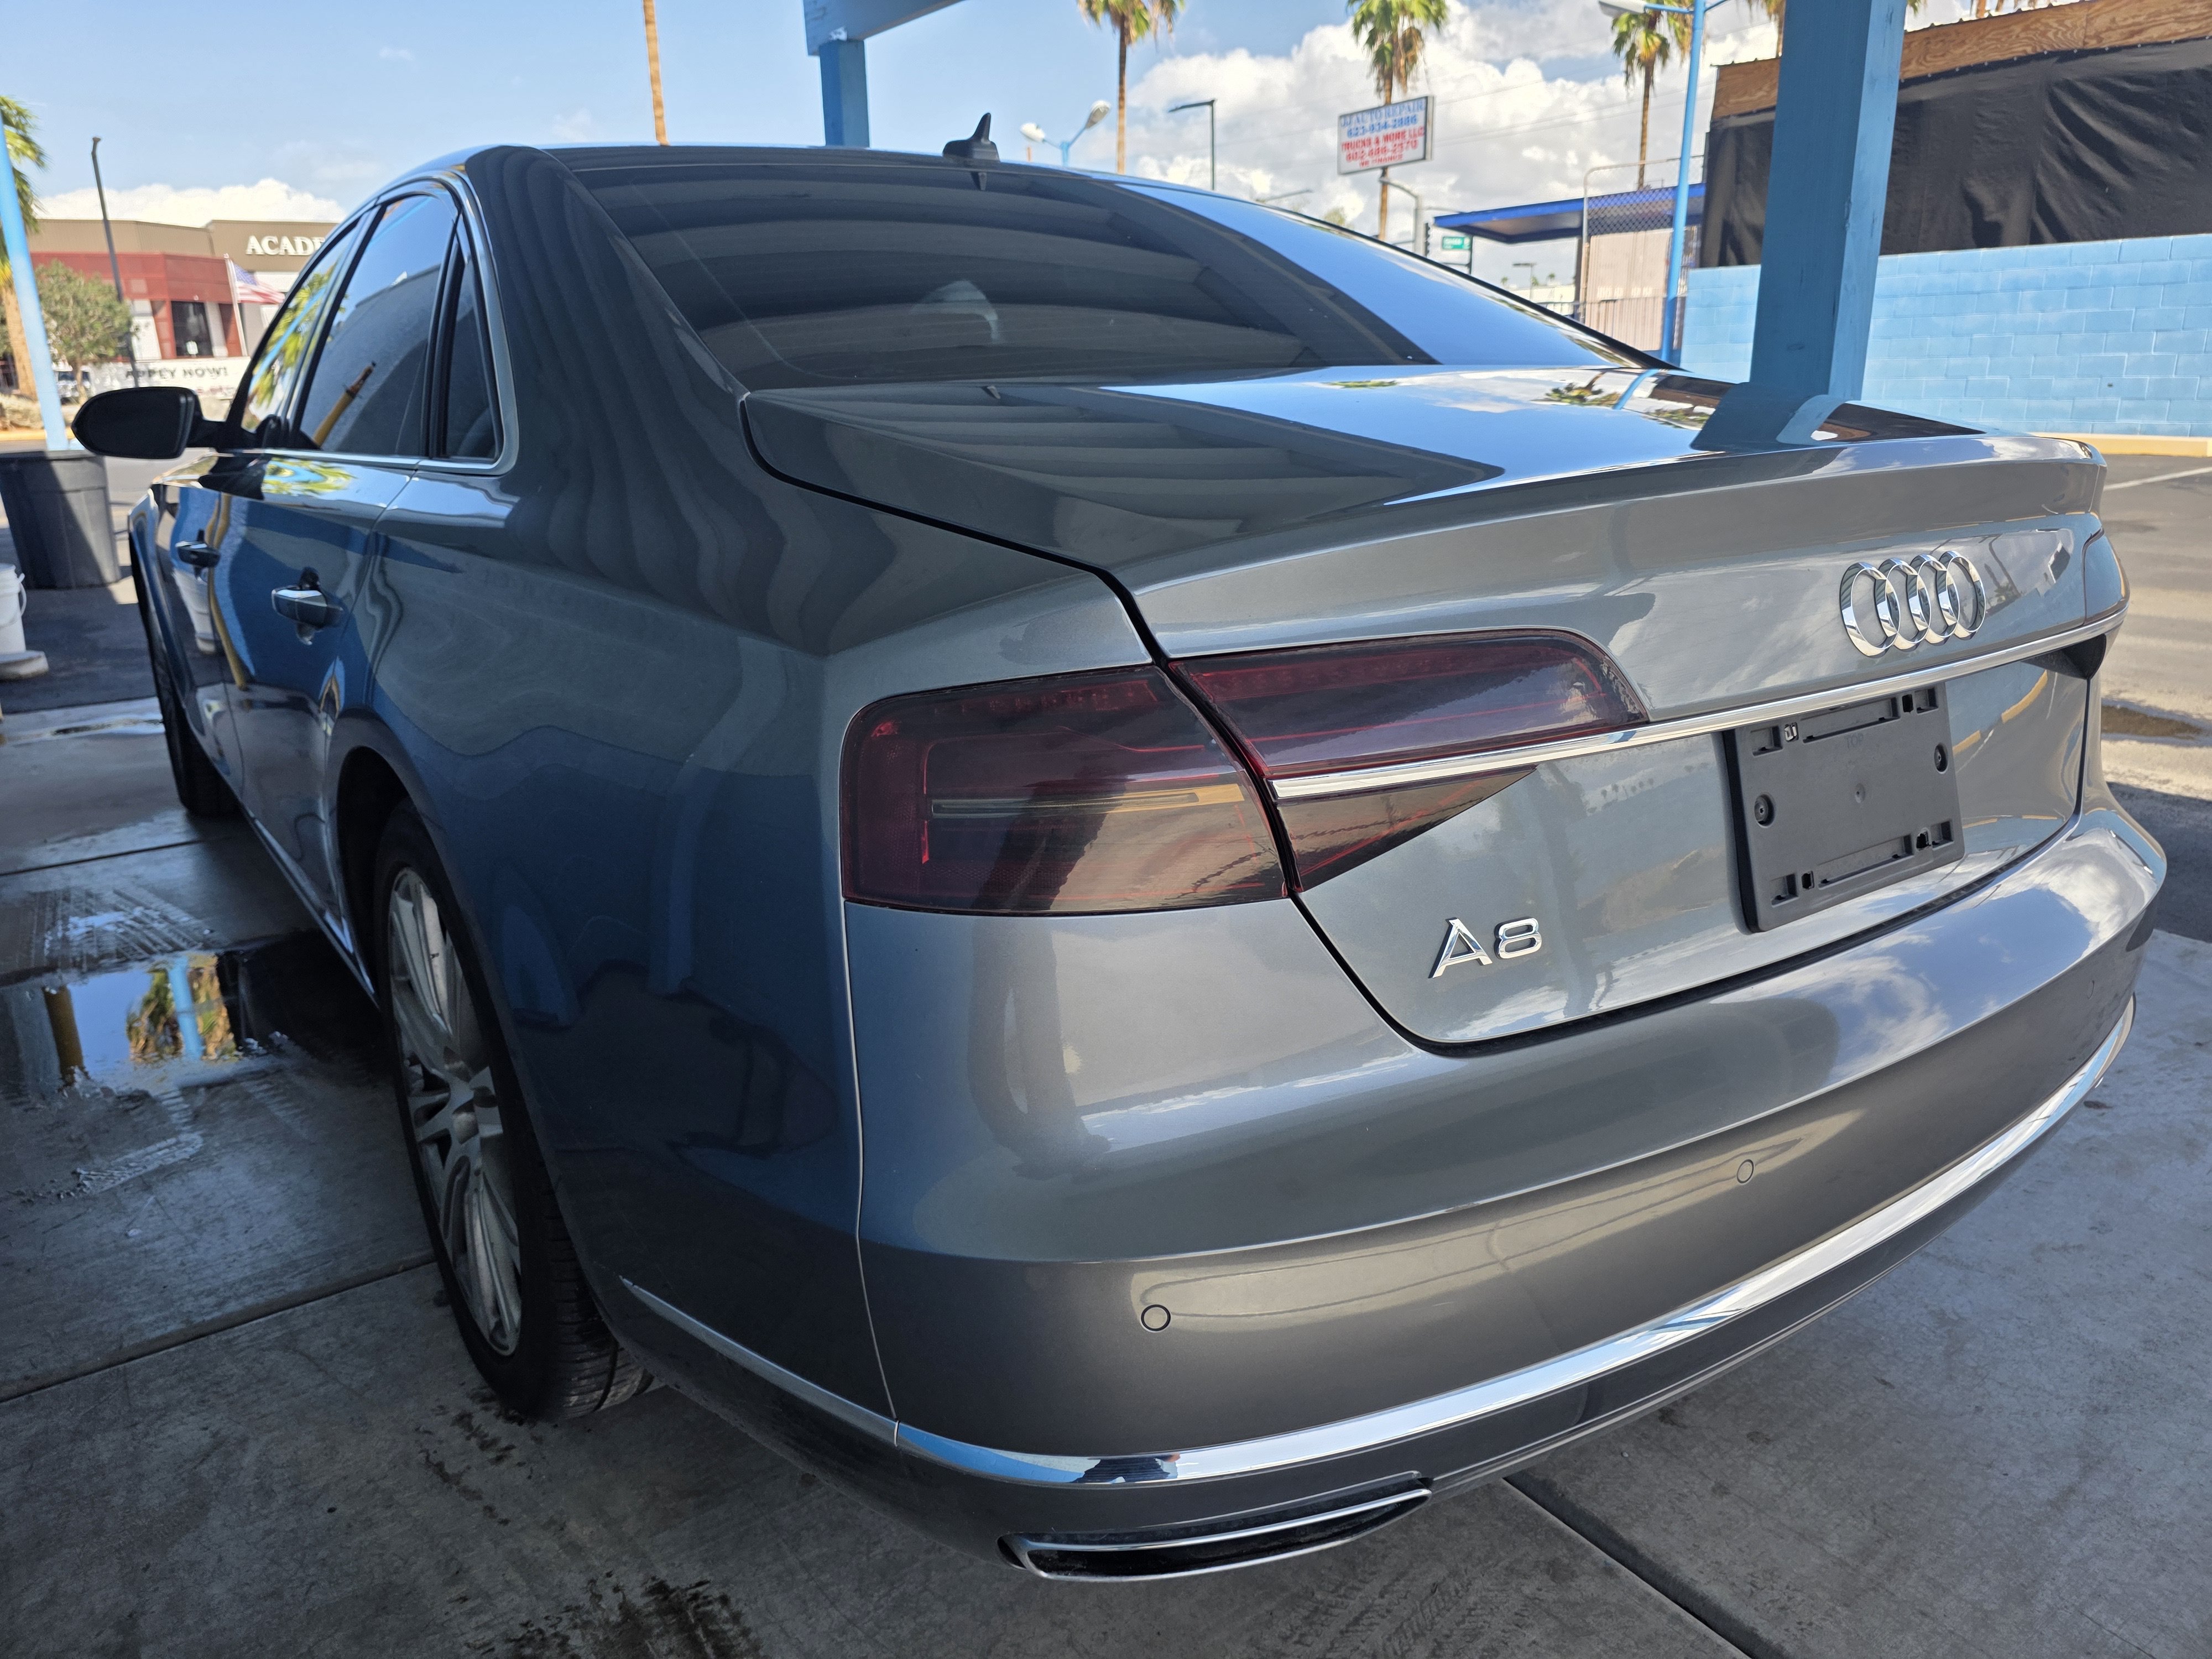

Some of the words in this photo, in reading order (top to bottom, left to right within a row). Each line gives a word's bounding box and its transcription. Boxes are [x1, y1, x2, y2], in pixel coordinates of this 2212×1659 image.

[1353, 110, 1383, 123] AUTO
[1384, 100, 1425, 117] REPAIR
[1342, 138, 1371, 152] TRUCKS
[1383, 130, 1406, 143] MORE
[1408, 126, 1424, 138] LLC
[1844, 733, 1864, 749] TOP
[1428, 916, 1542, 978] A8
